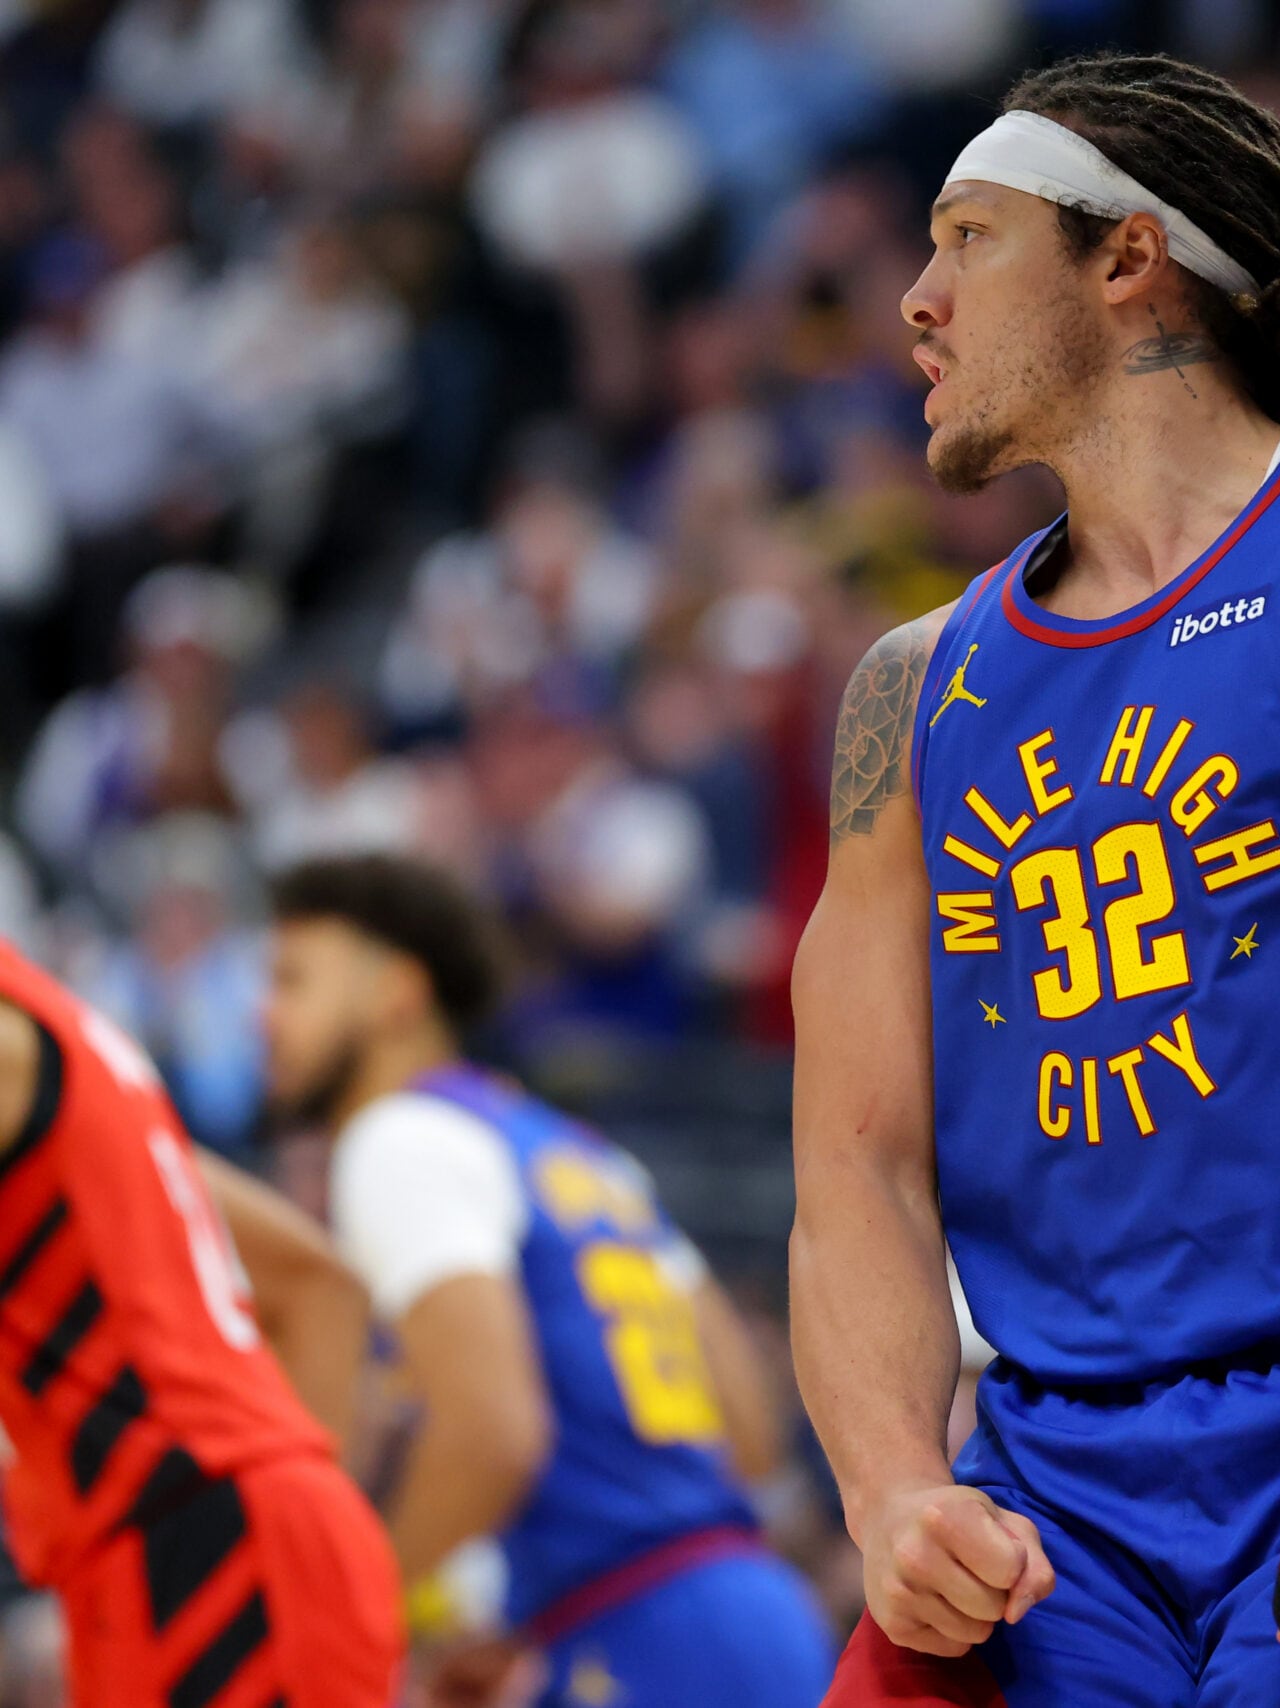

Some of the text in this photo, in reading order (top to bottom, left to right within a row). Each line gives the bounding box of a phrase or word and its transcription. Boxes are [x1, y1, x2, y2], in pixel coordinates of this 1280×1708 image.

[1170, 596, 1266, 647] ibotta
[937, 727, 1075, 954] MILE
[1010, 819, 1192, 1021] 32
[1037, 1009, 1218, 1146] CITY
